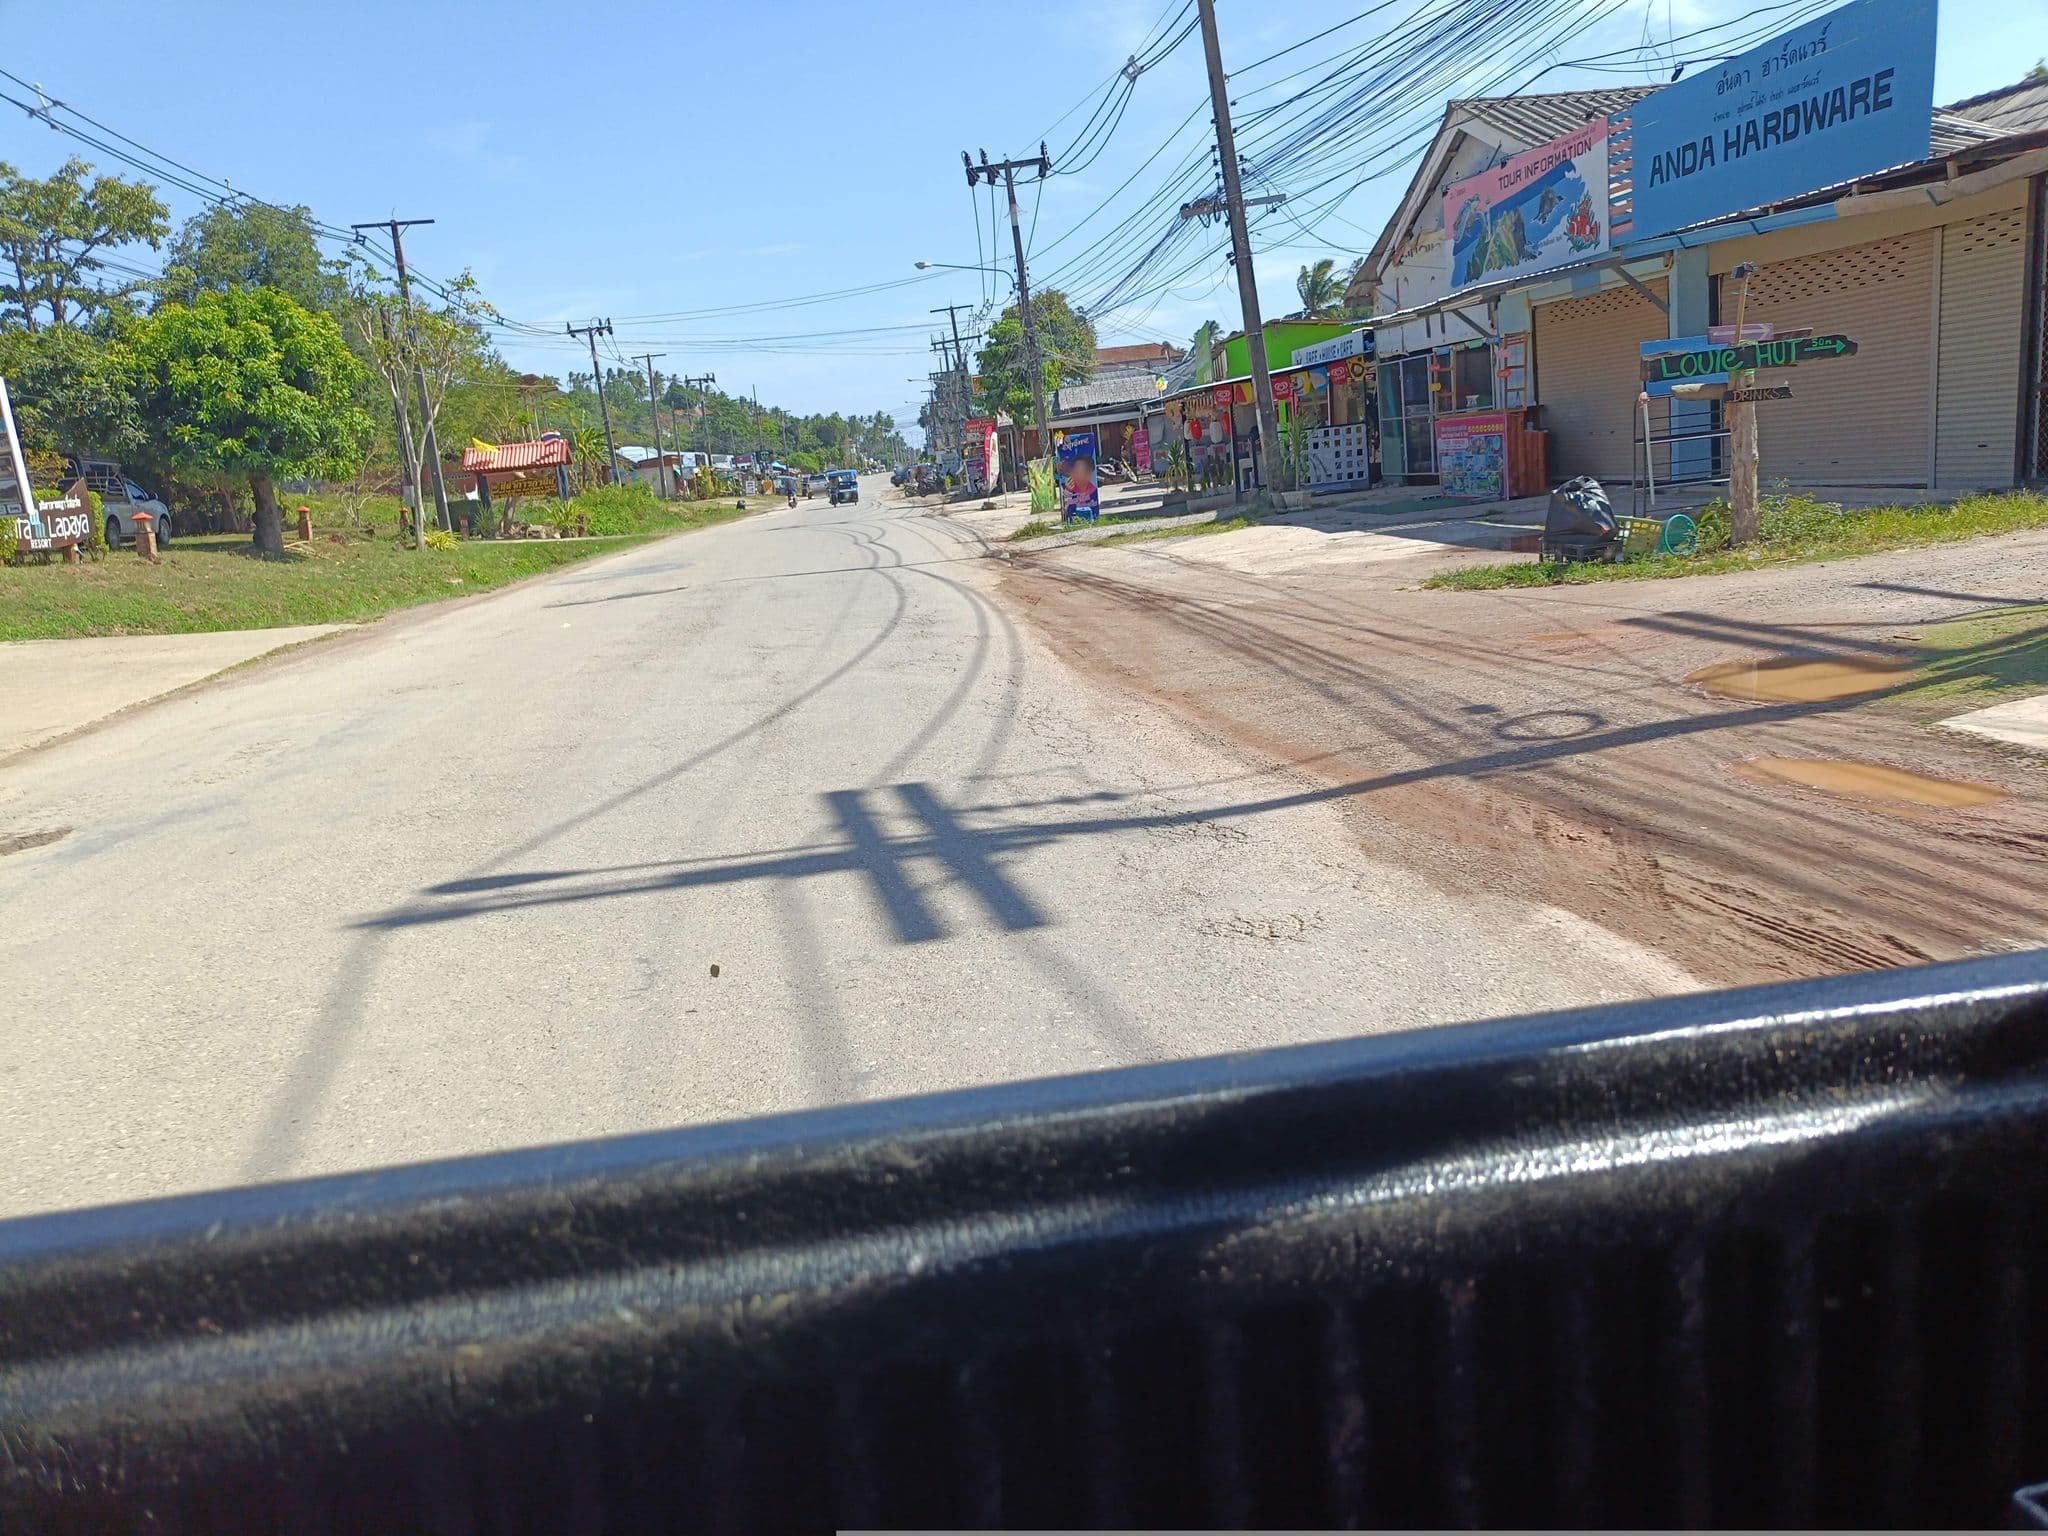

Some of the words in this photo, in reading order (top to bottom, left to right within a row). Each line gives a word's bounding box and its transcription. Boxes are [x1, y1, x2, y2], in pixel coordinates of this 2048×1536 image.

[1761, 21, 1833, 78] ฮาร์ดแวร์
[1649, 134, 1716, 189] ANDA
[1723, 66, 1896, 163] HARDWARE
[1498, 169, 1522, 191] TOUR
[1524, 137, 1592, 179] INFORMATION
[1754, 339, 1804, 368] HUT
[1732, 389, 1780, 401] DRINKS
[47, 513, 90, 540] Lapaya
[31, 538, 52, 549] RESORT
